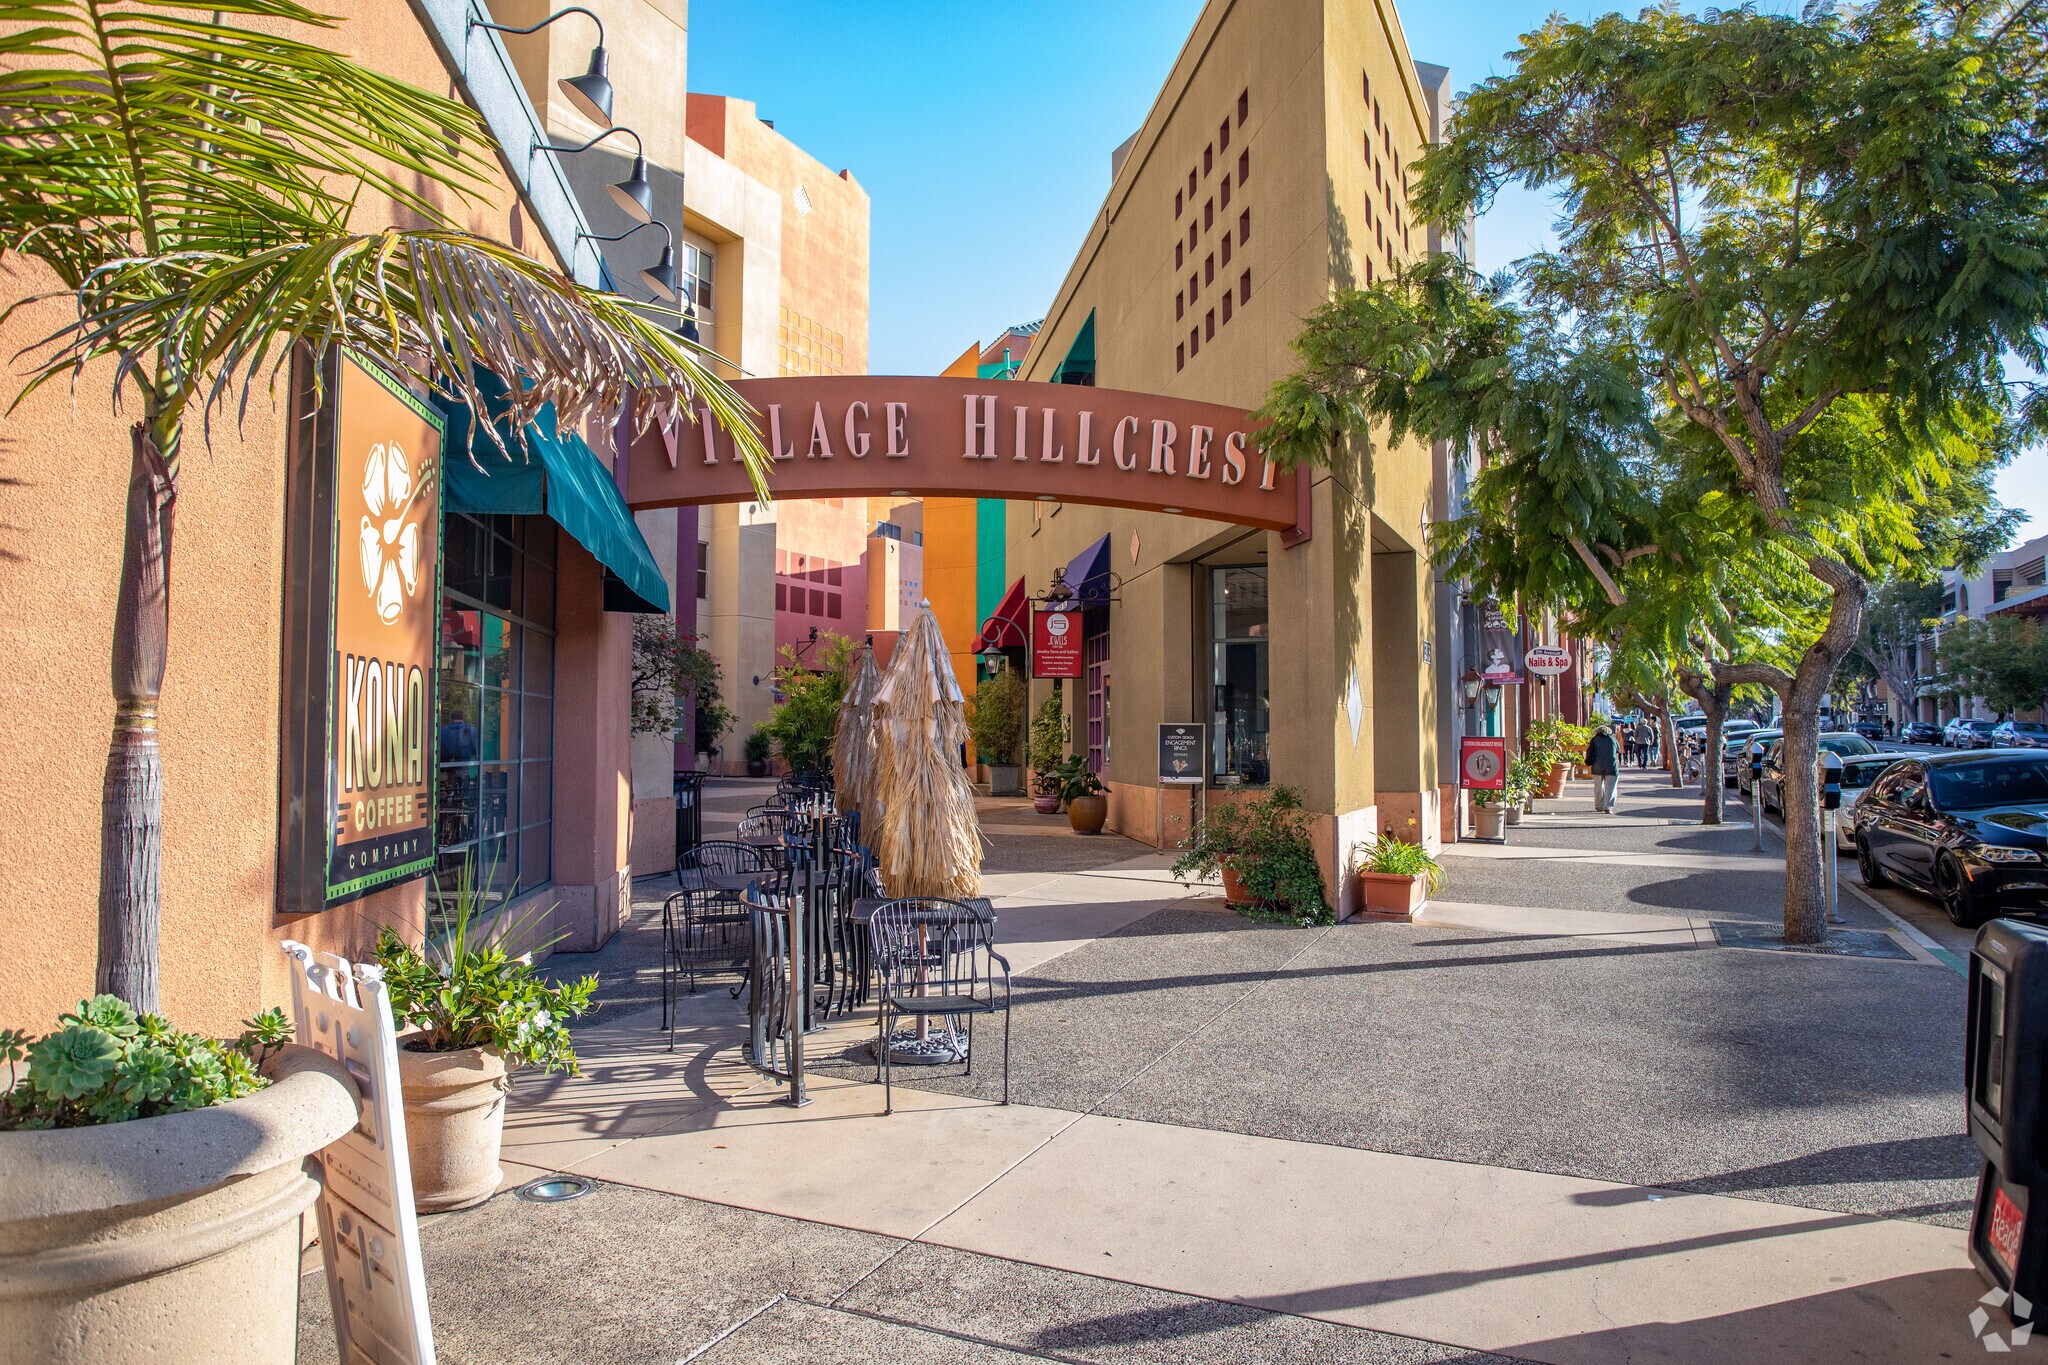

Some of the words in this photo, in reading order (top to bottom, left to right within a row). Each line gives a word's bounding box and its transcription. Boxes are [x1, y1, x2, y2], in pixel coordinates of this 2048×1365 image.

[654, 401, 909, 469] VILAGE
[1528, 657, 1546, 667] Nails
[1548, 657, 1553, 667] &
[1555, 656, 1568, 669] Spa
[345, 654, 424, 793] KONA
[355, 794, 413, 832] COFFEE
[349, 838, 419, 870] COMPANY
